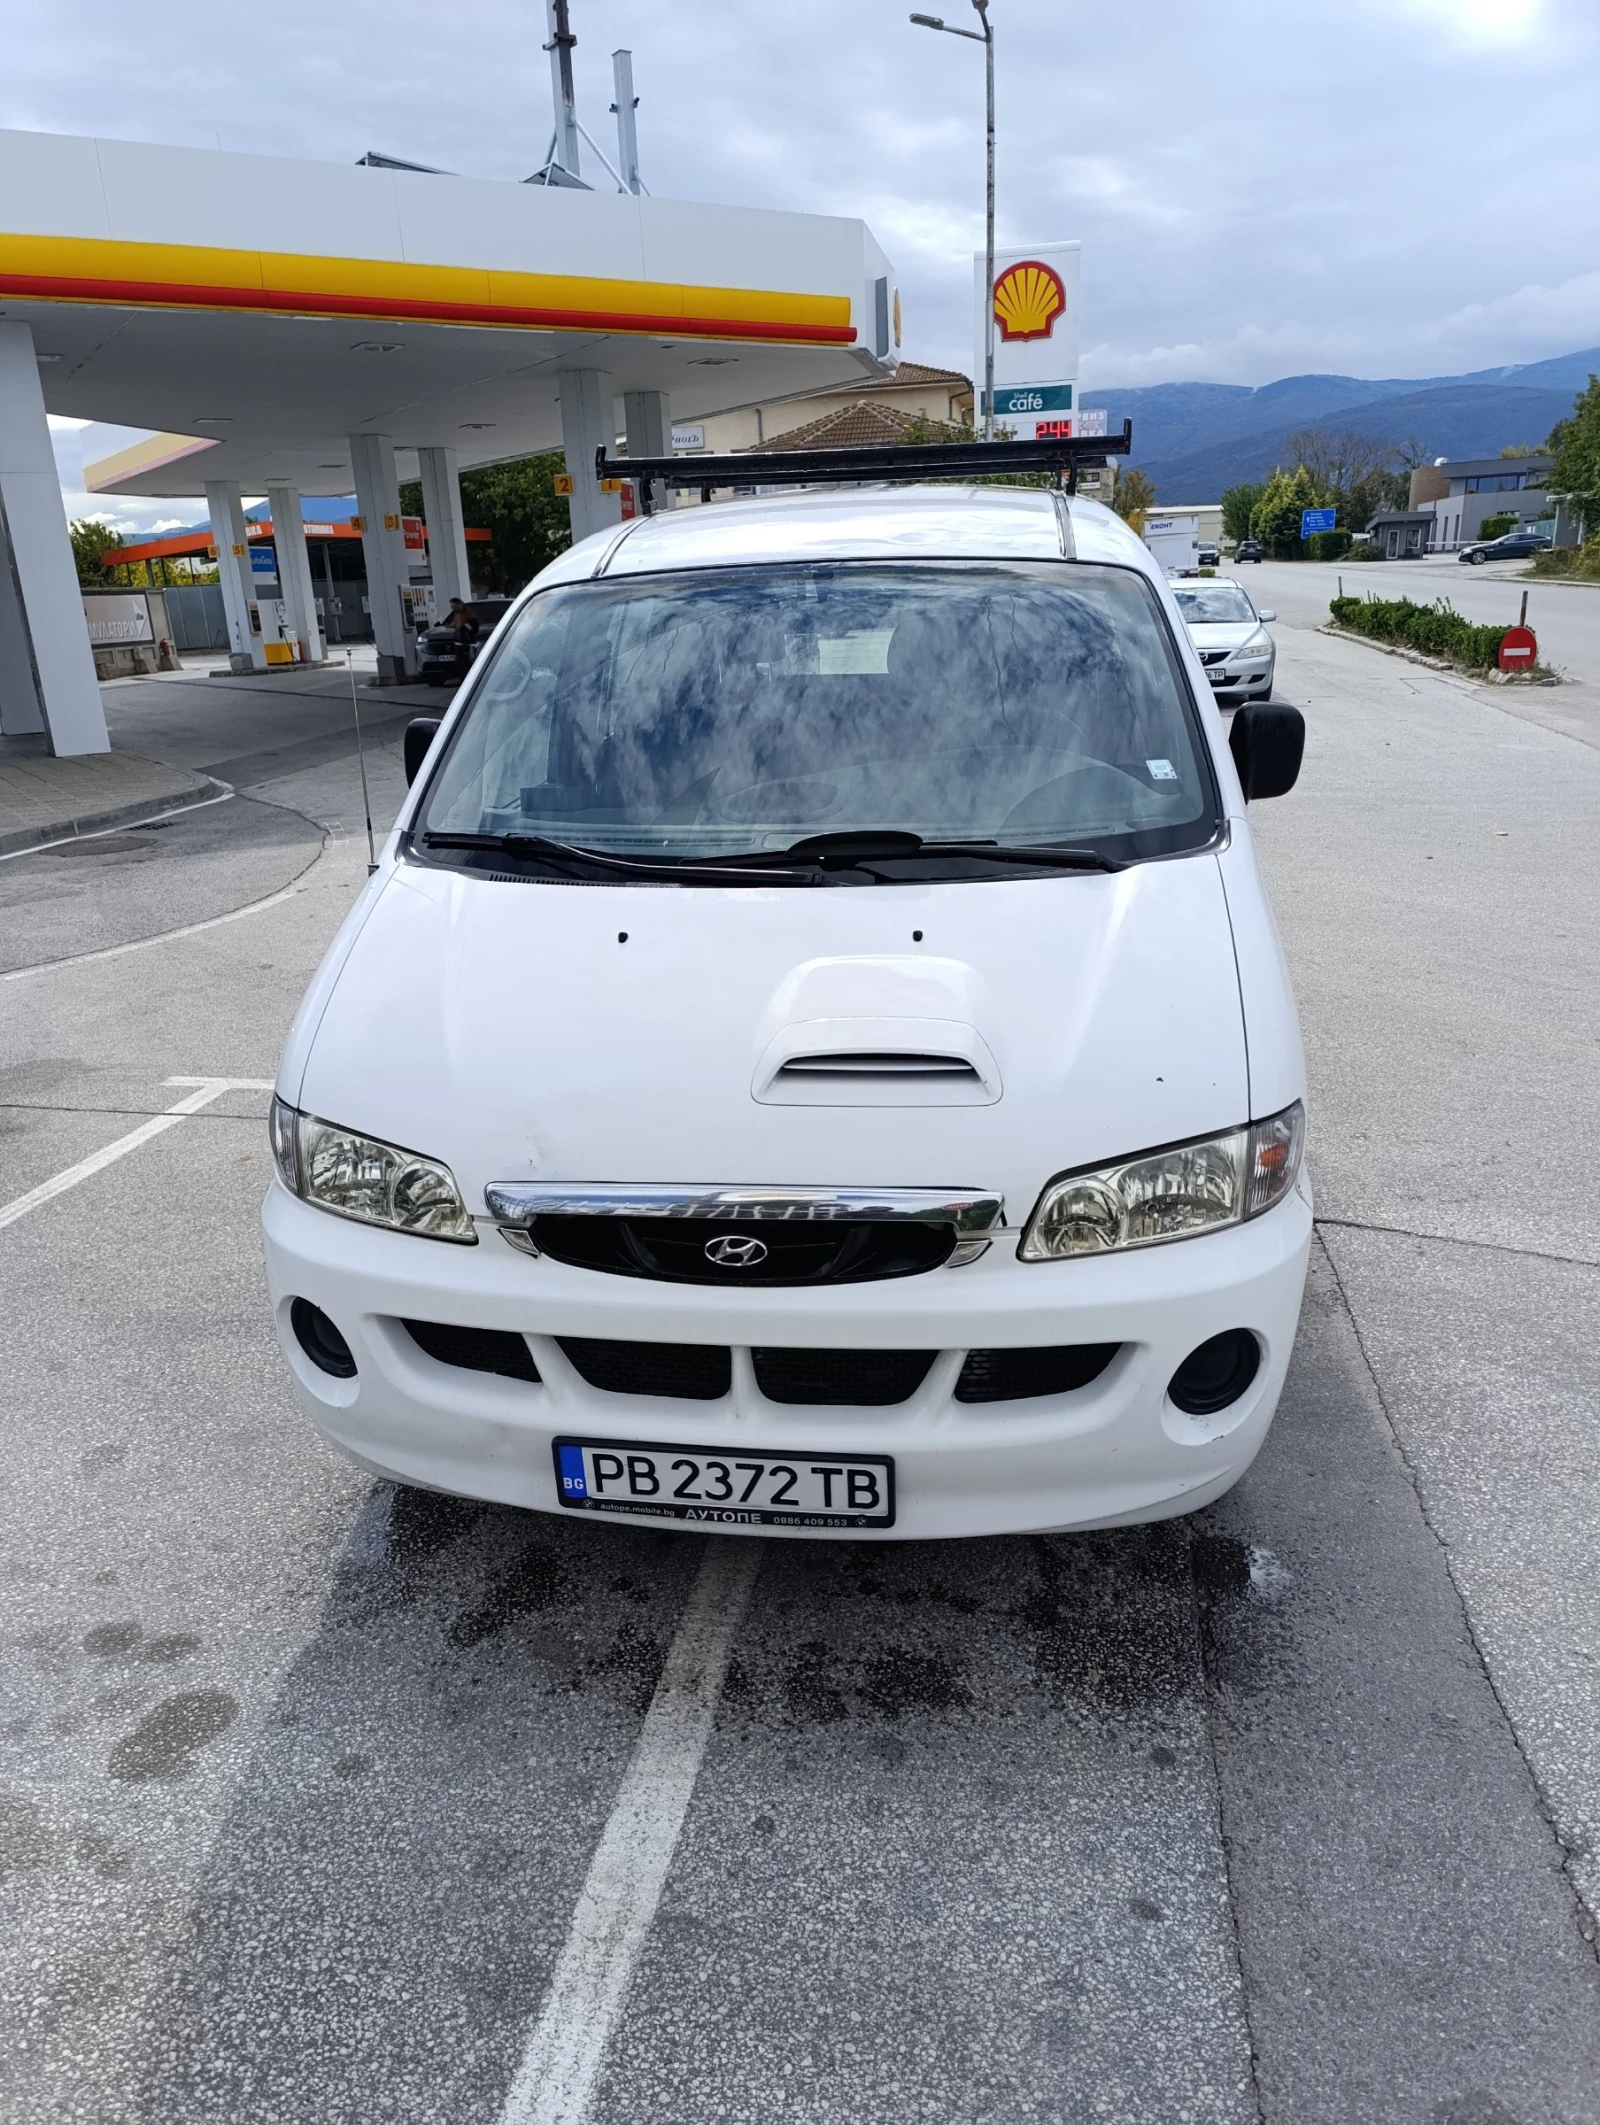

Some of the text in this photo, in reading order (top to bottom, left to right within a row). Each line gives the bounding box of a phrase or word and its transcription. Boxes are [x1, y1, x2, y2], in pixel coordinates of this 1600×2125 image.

[1008, 393, 1043, 411] café
[1036, 420, 1072, 439] 244
[559, 477, 570, 492] 2
[607, 479, 613, 490] 1
[352, 518, 361, 529] 4
[387, 516, 395, 528] 3
[209, 548, 217, 556] 6
[234, 546, 241, 554] 5
[563, 1477, 584, 1490] BG
[592, 1453, 880, 1509] PB 2372 TB
[600, 1503, 675, 1518] autope.mobile.bg
[685, 1508, 762, 1524] АУТОПЕ
[773, 1516, 848, 1527] 0886 409 553
